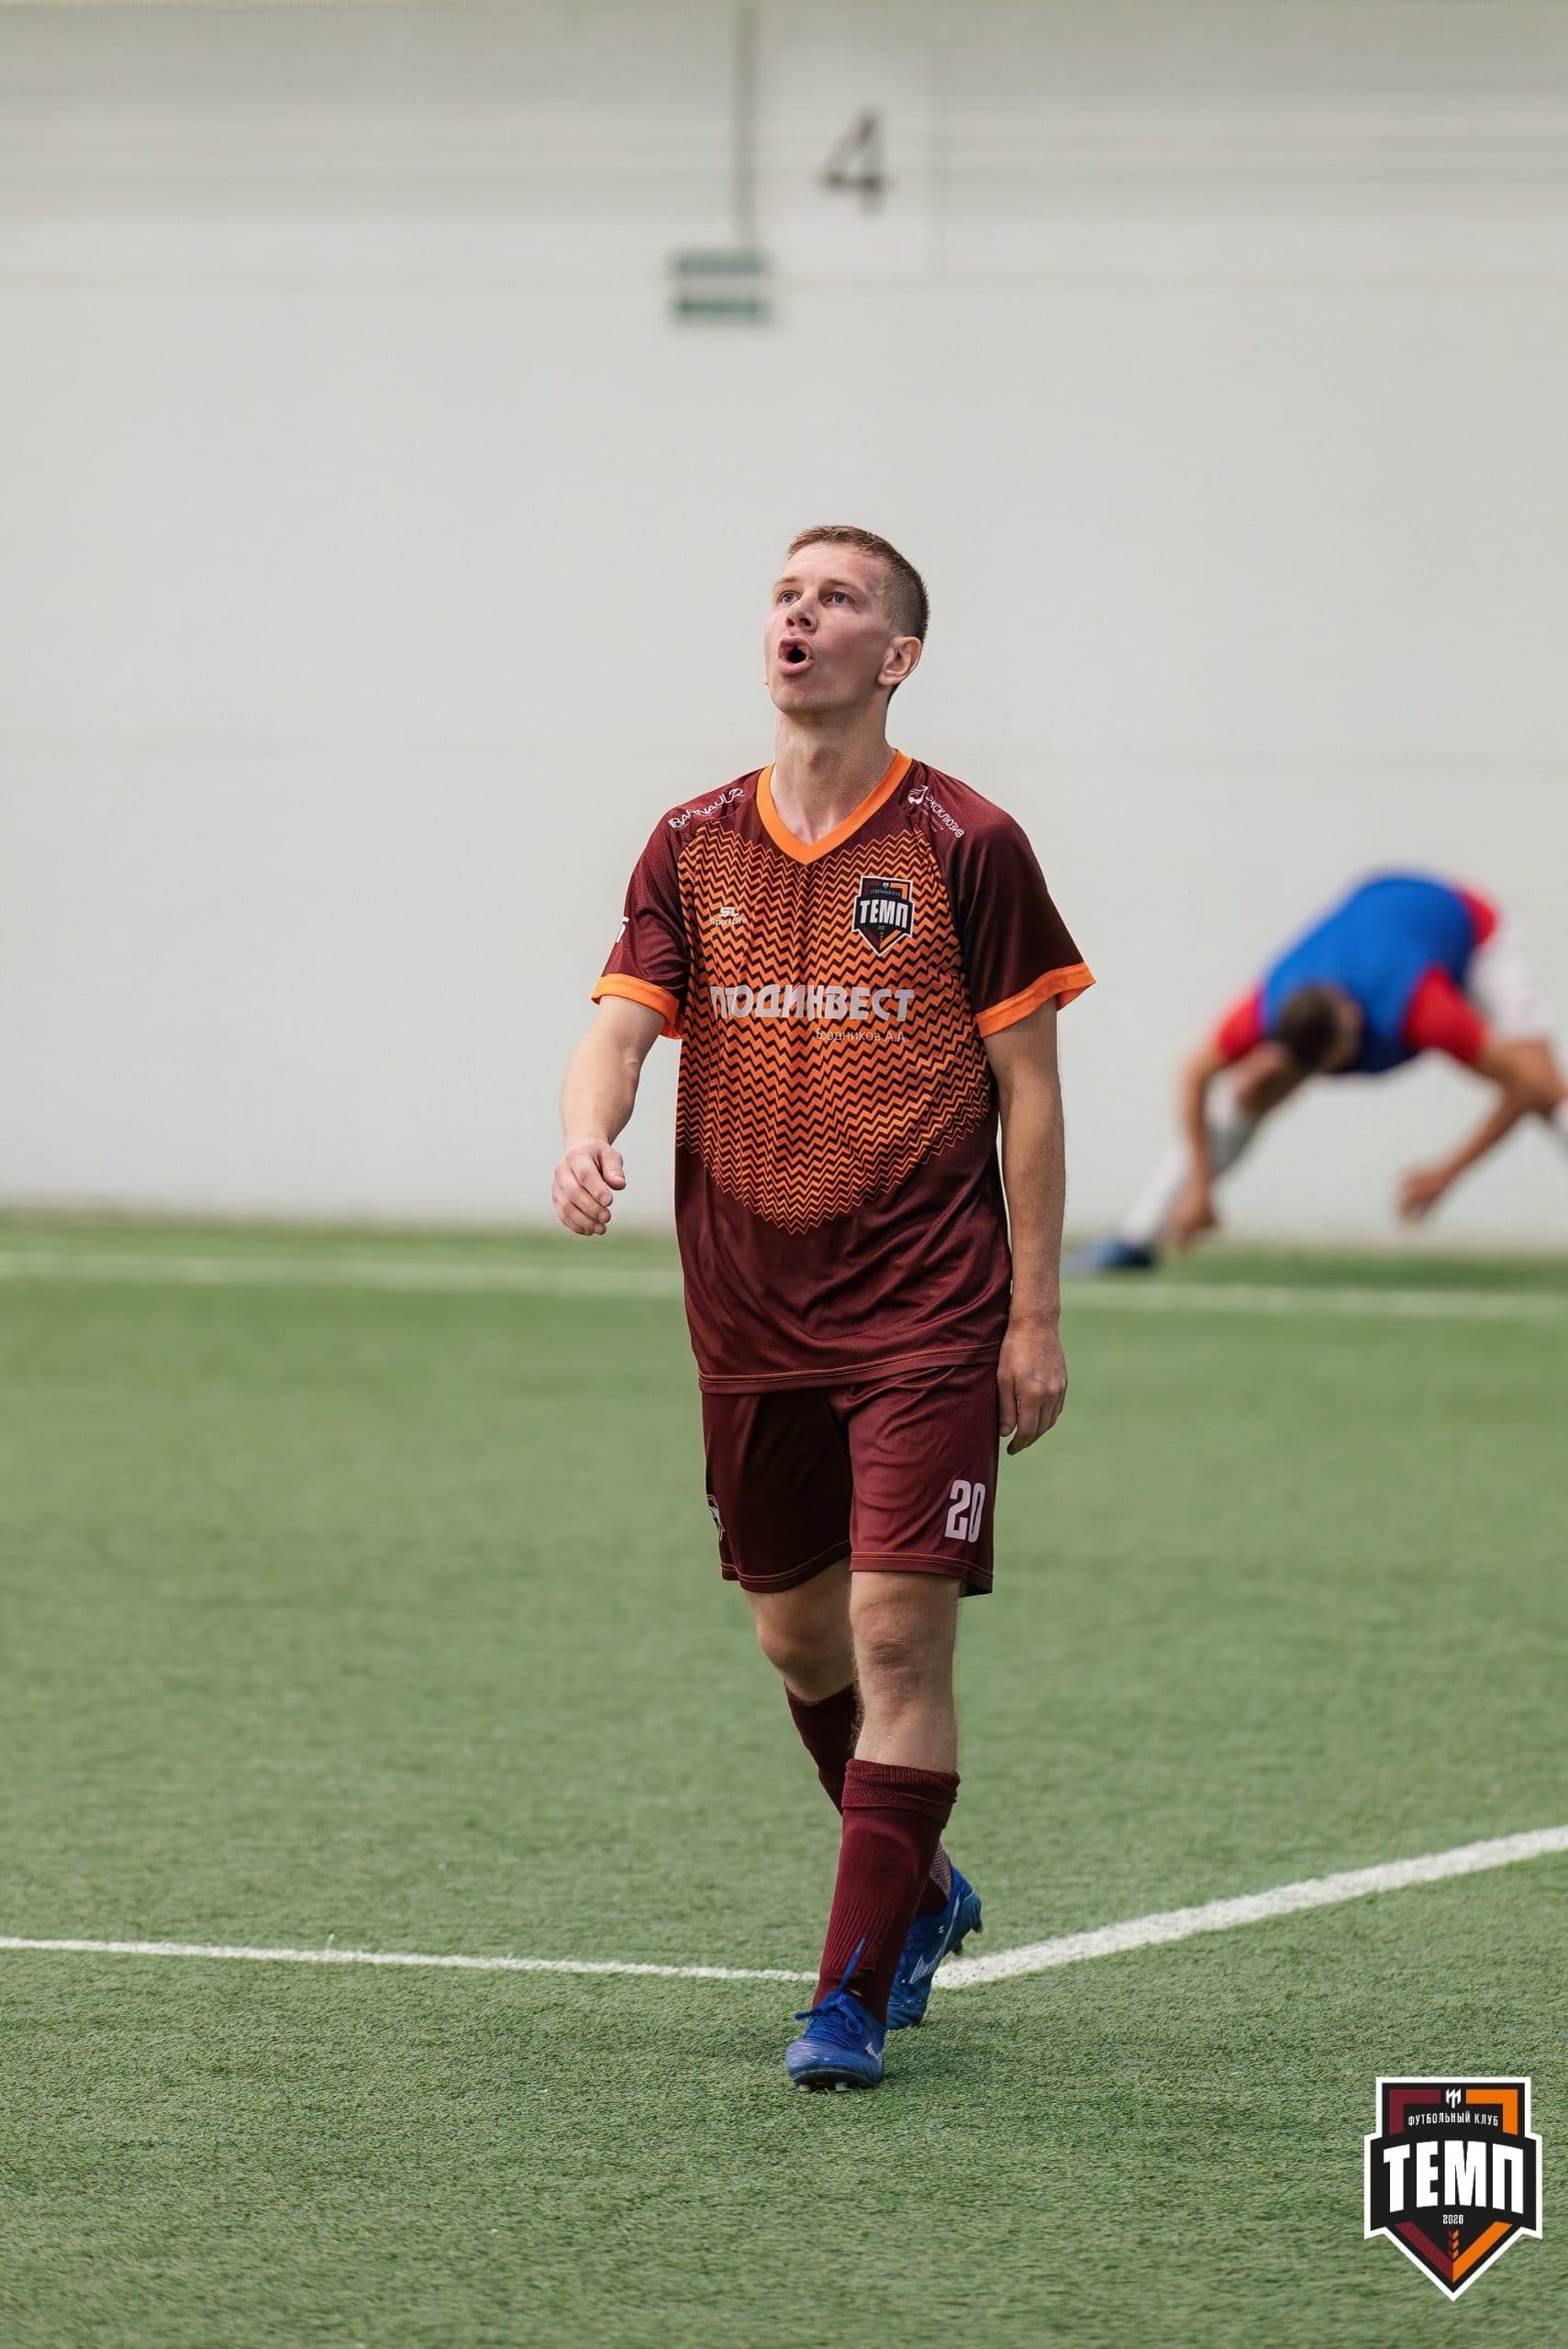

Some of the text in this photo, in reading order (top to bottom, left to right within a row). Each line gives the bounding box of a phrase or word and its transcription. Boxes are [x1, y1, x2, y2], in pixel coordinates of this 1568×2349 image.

[817, 107, 894, 216] 4
[860, 899, 908, 929] ТЕМП
[944, 1479, 986, 1542] 20
